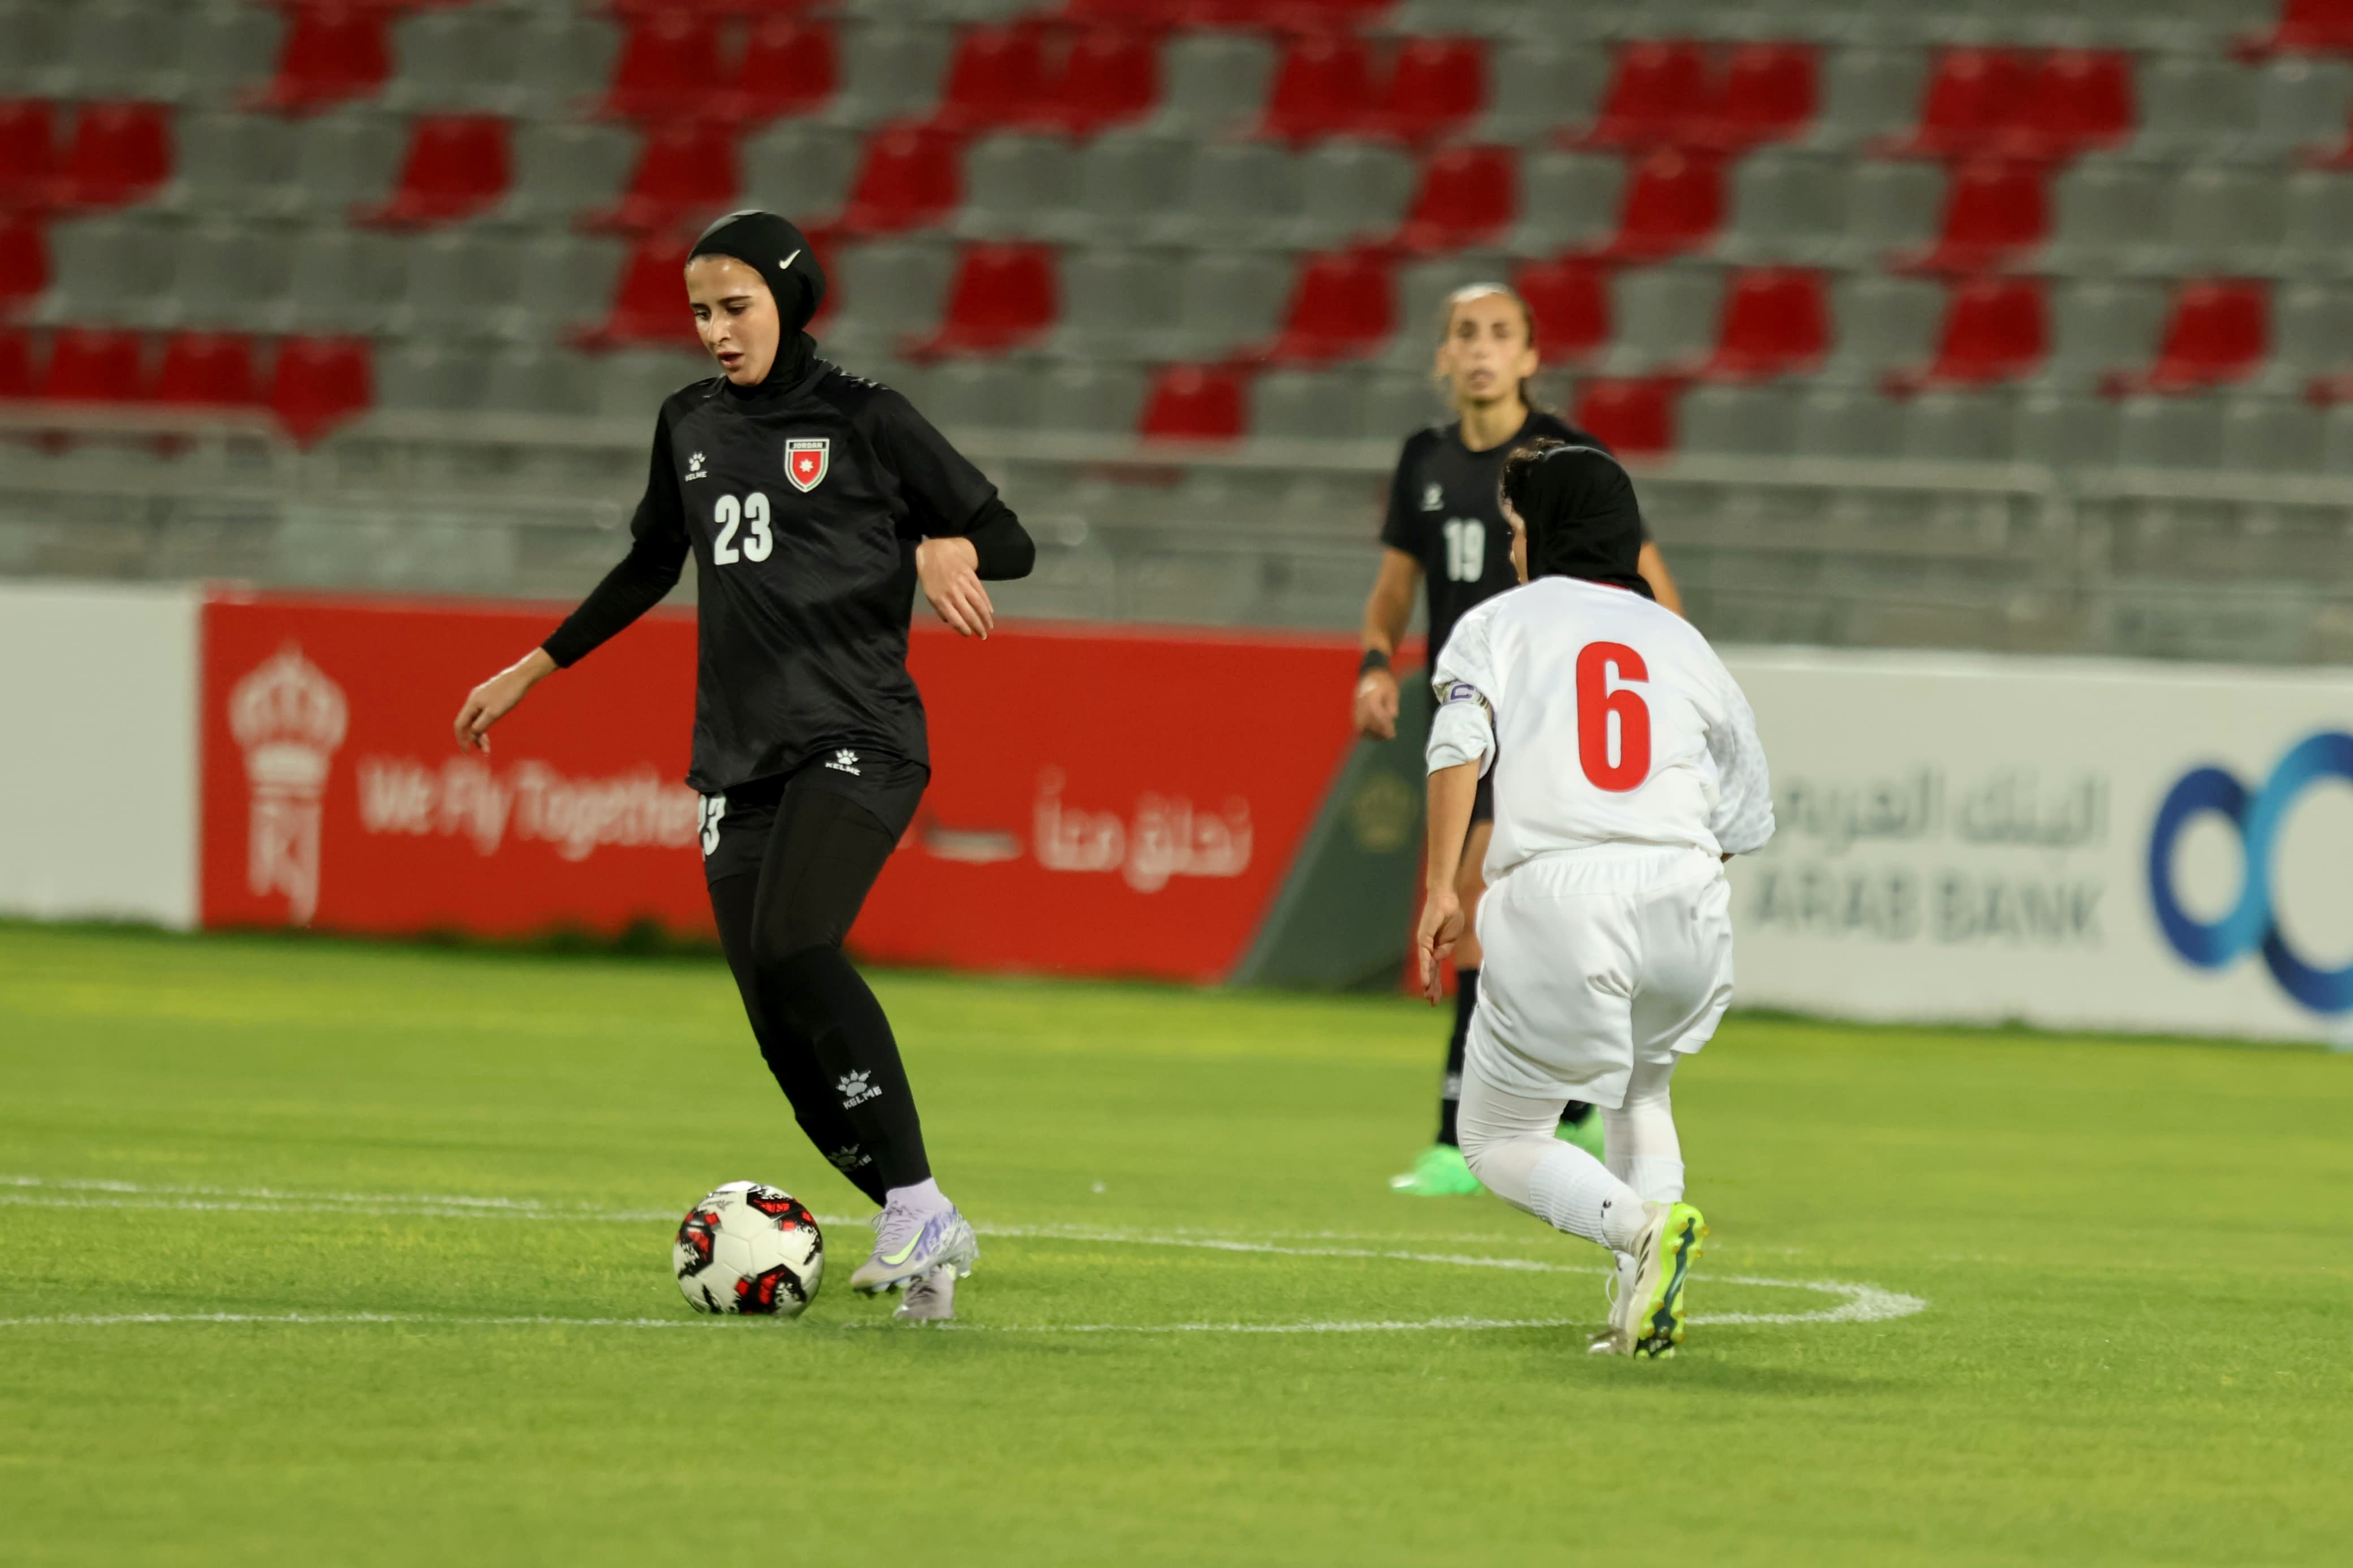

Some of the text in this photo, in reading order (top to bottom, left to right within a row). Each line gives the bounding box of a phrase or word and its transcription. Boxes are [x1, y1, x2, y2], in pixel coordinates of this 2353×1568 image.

[713, 492, 773, 565] 23
[1442, 517, 1486, 582] 19
[1576, 641, 1652, 792] 6
[825, 762, 861, 776] KELME
[356, 754, 698, 861] We Fly Togethe
[1749, 867, 2105, 950] ARAB BANK
[843, 1085, 882, 1110] KELME
